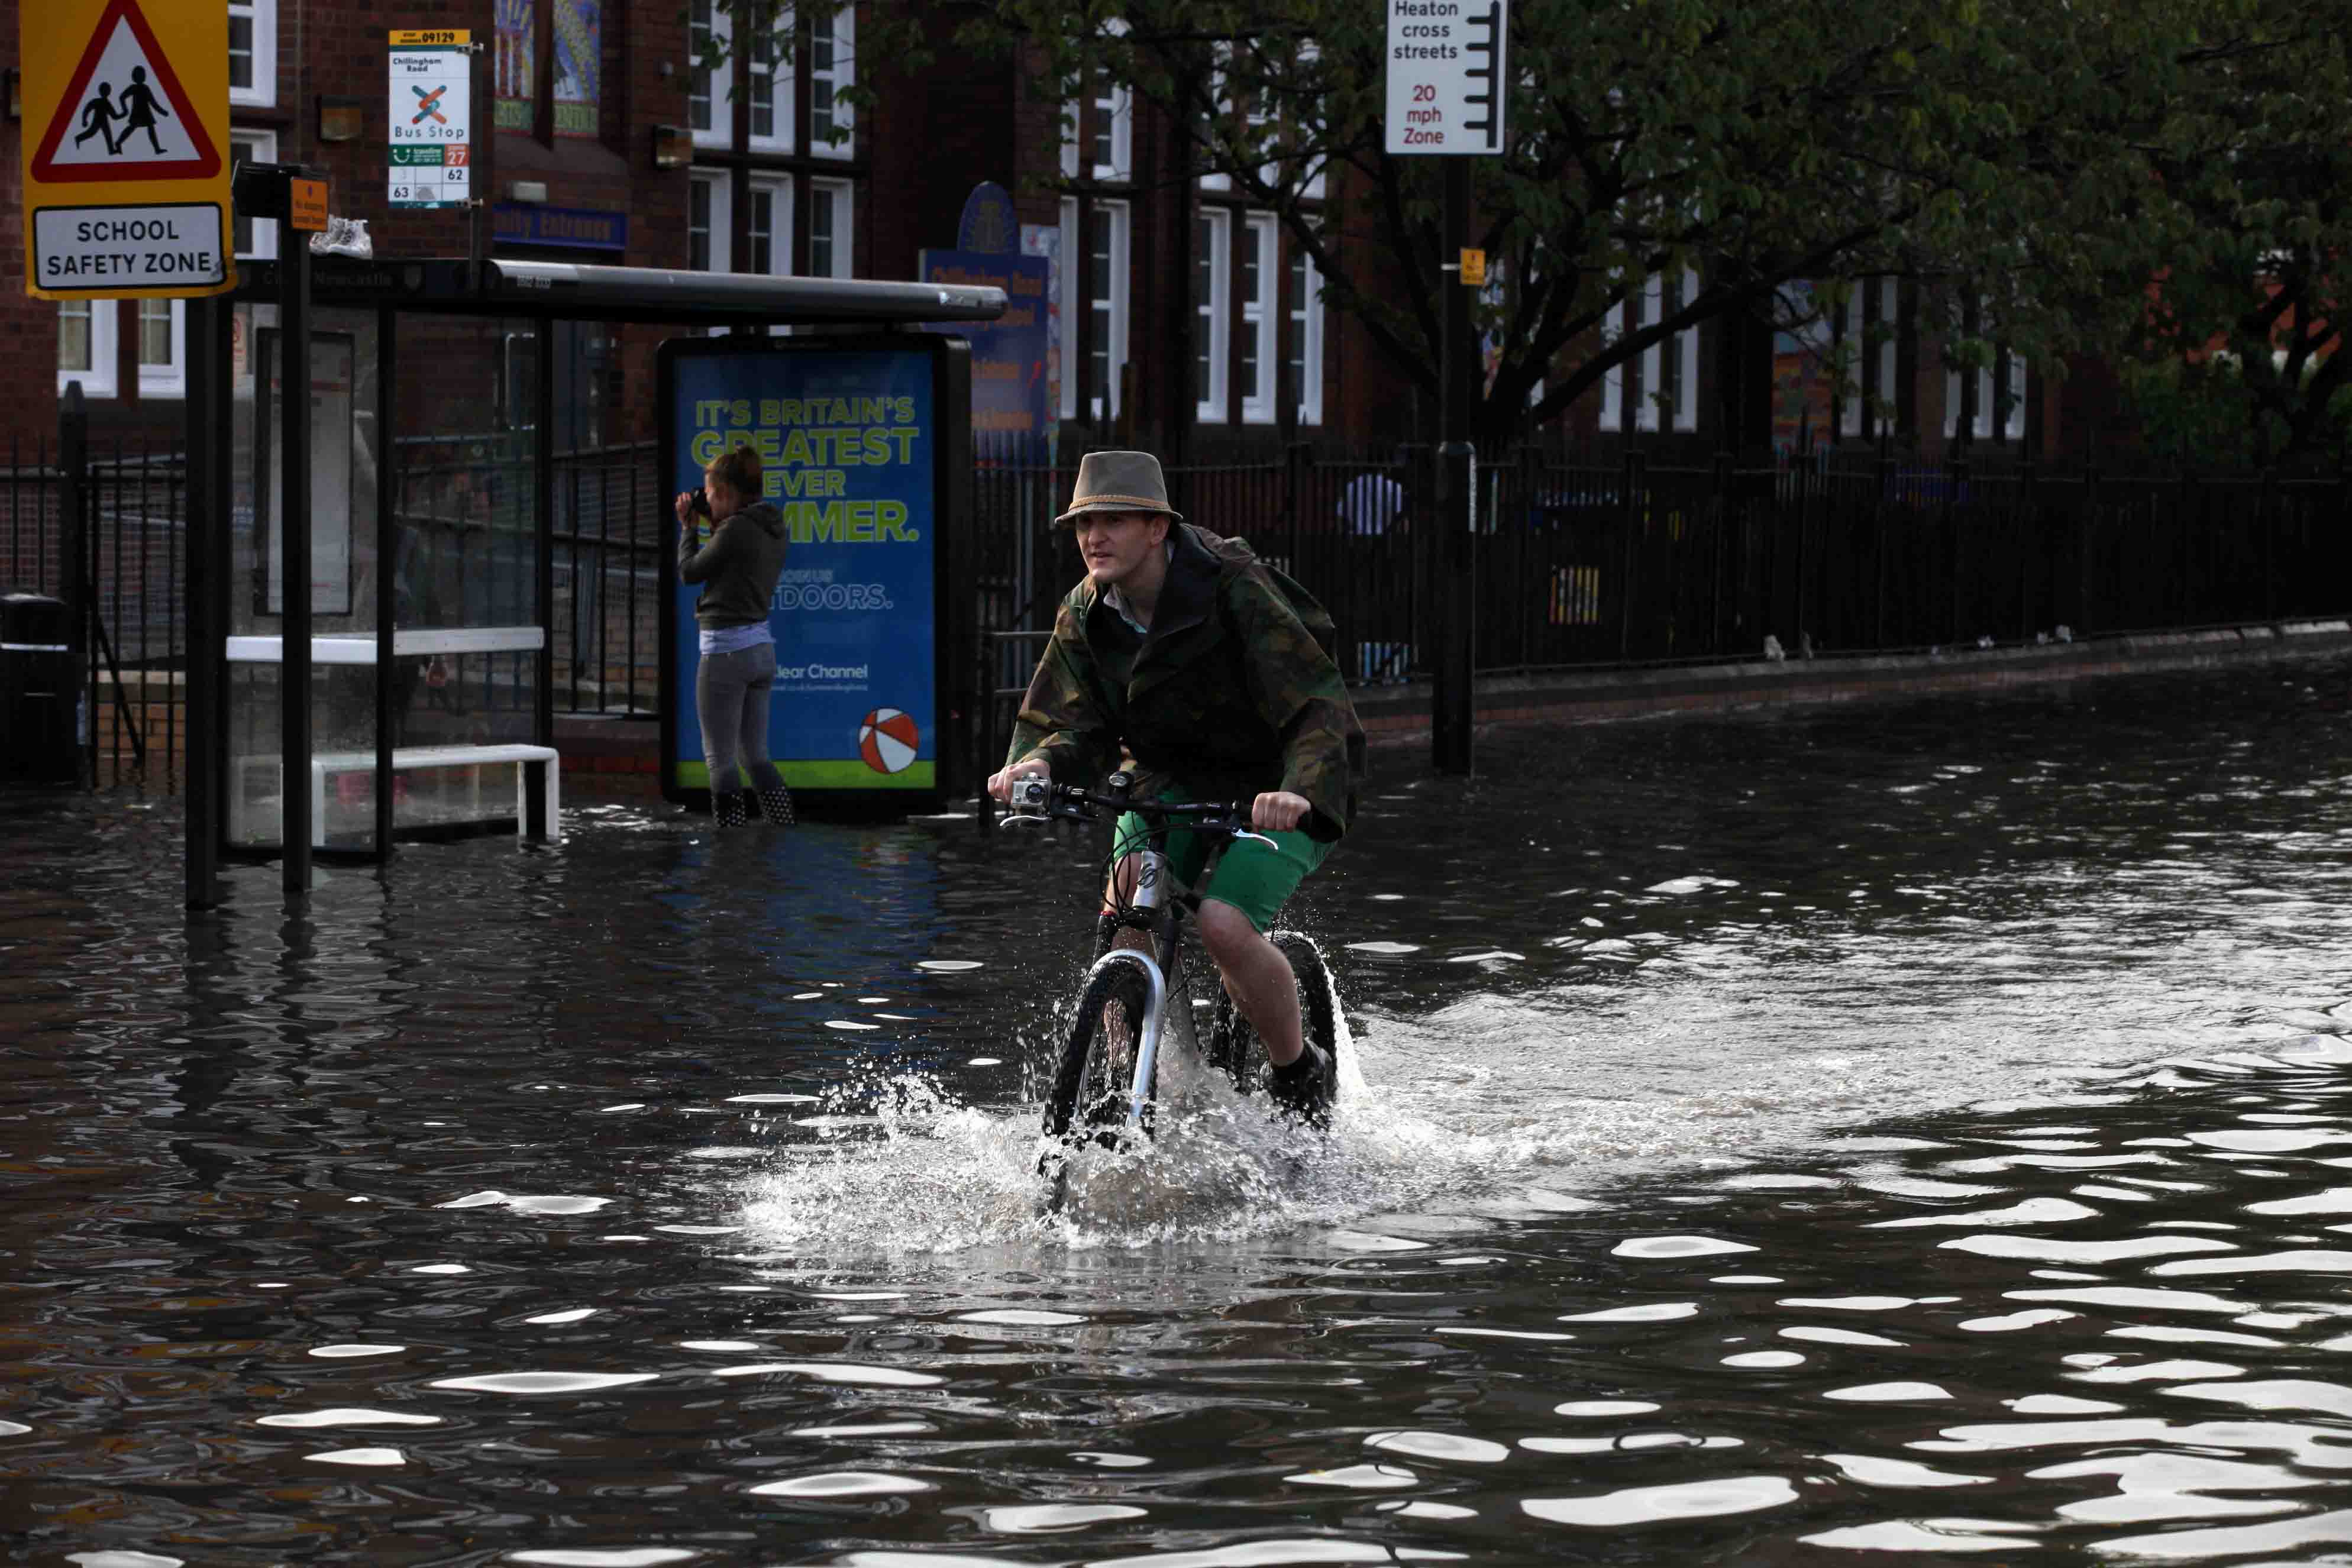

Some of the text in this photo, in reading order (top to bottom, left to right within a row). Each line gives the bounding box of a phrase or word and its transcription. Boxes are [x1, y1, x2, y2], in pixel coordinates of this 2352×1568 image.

[1395, 1, 1458, 16] Heaton
[422, 33, 455, 43] 09129
[1401, 25, 1450, 37] cross
[1394, 44, 1458, 59] streets
[1413, 85, 1436, 102] 20
[1406, 107, 1442, 125] mph
[395, 125, 464, 140] Bus Stop
[1404, 127, 1444, 144] Zone
[448, 151, 465, 165] 27
[448, 170, 463, 180] 62
[394, 187, 409, 198] 63
[77, 220, 179, 242] SCHOOL
[47, 252, 212, 276] SAFETY ZONE
[696, 397, 915, 426] IT'S BRITAIN'S
[763, 470, 847, 498] EVER
[769, 584, 894, 610] DOORS.
[776, 663, 868, 678] lear Channel
